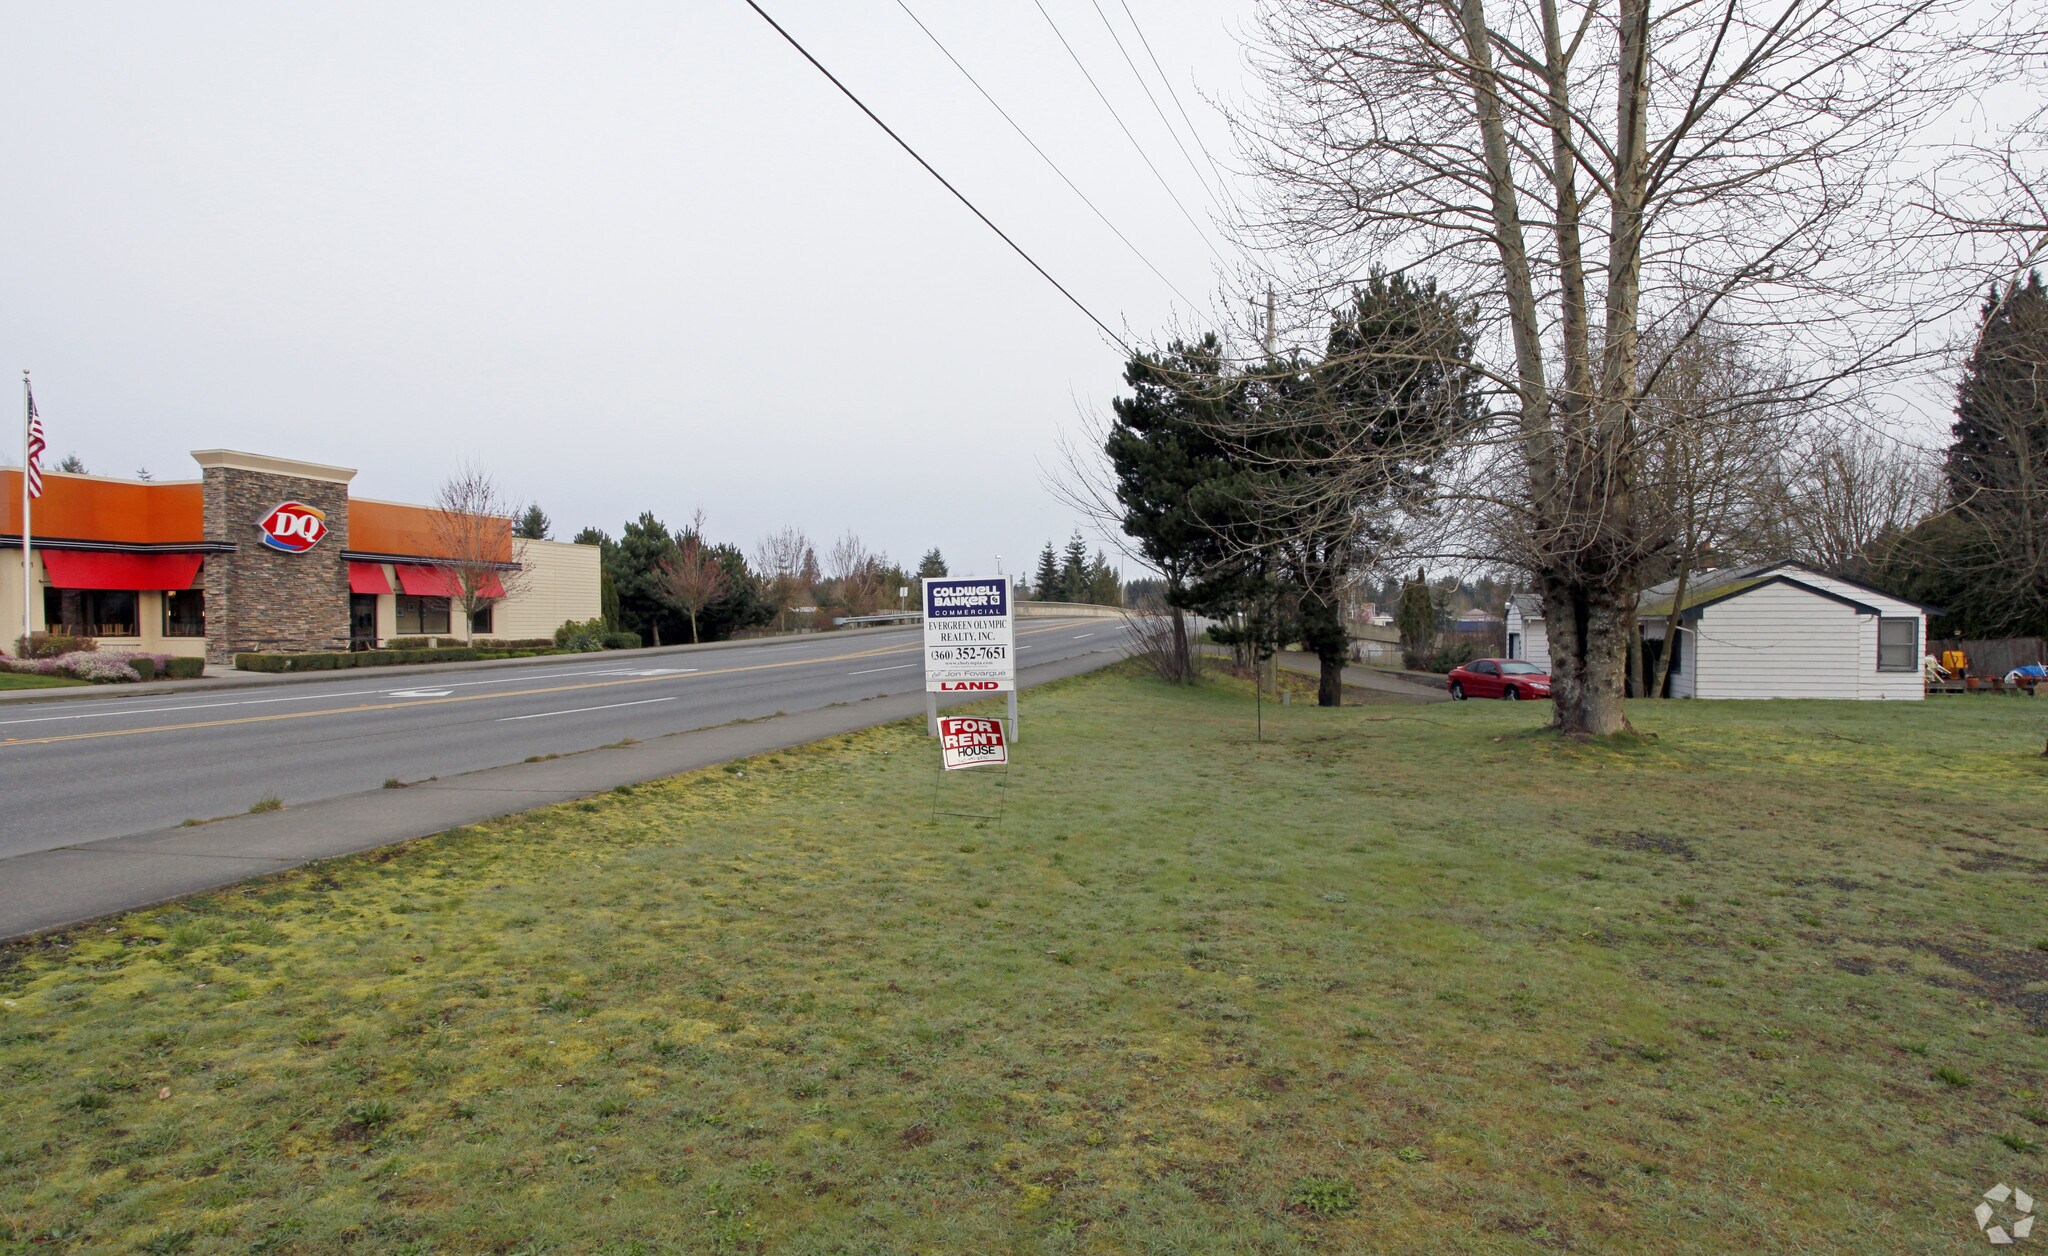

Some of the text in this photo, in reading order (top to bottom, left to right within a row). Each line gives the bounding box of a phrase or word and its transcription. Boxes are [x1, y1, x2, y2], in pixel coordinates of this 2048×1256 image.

[273, 512, 319, 542] DQ
[933, 585, 1000, 597] COLDWELL
[934, 595, 988, 607] BANKER
[928, 619, 1007, 630] EVERGREEN OLYMPIC
[941, 632, 995, 642] REALTY, INC.
[931, 647, 1006, 660] (360) 352-7651
[941, 682, 999, 691] LAND
[949, 720, 992, 733] FOR
[944, 733, 1000, 748] RENT
[958, 745, 996, 757] HOUSE
